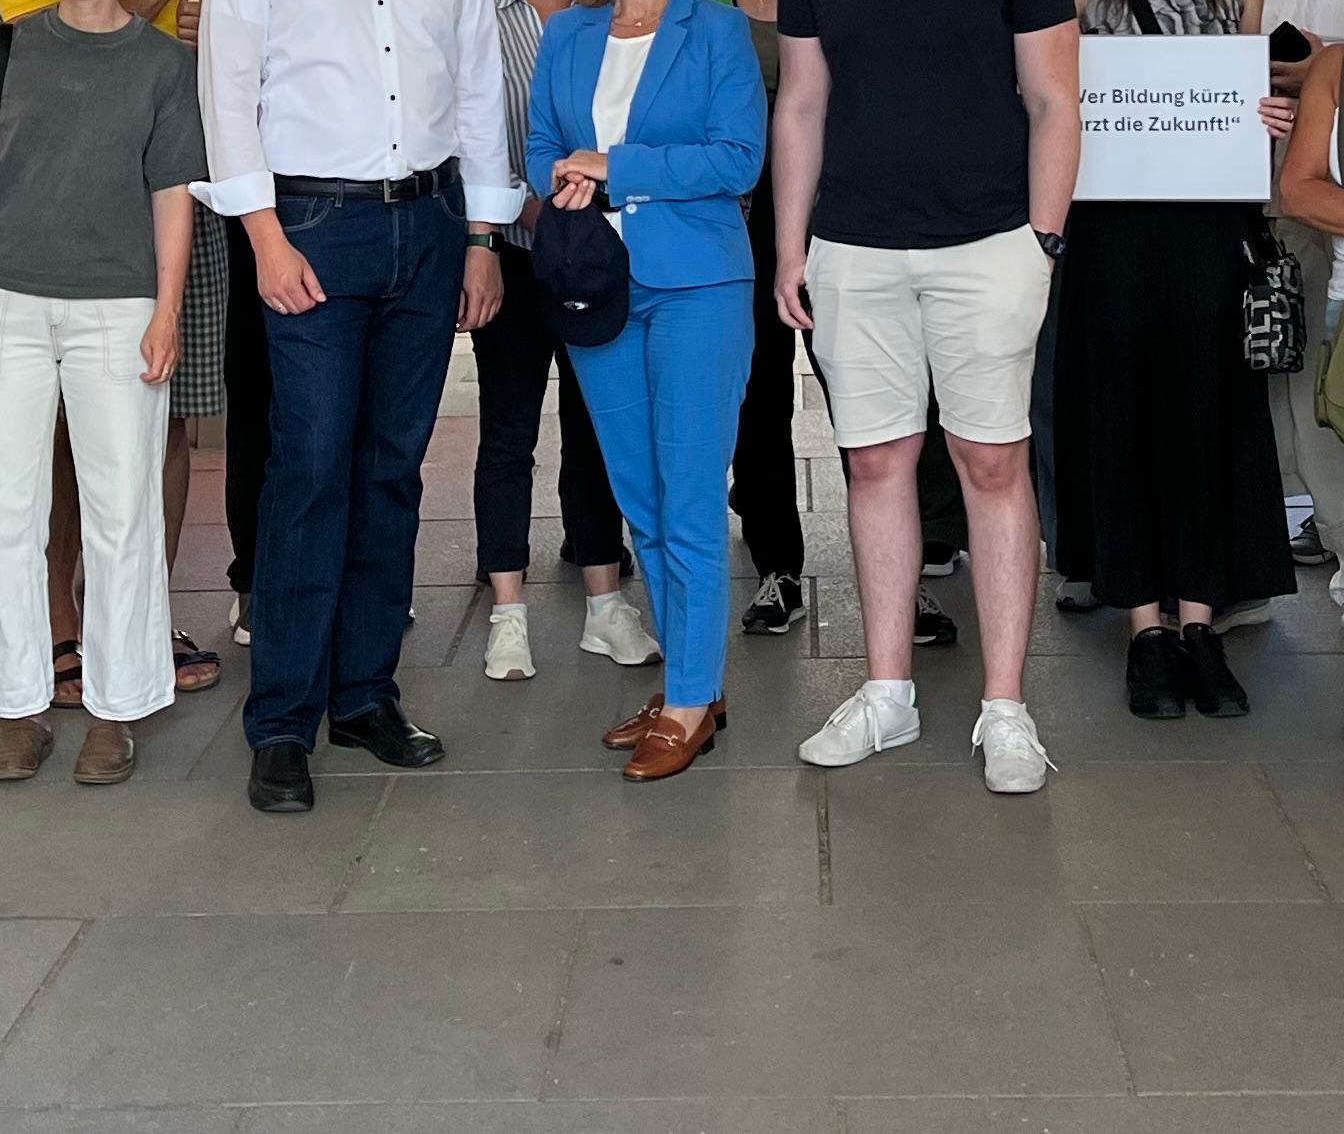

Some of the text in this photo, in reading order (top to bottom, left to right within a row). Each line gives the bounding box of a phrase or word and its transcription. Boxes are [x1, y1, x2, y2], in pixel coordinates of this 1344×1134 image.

[1111, 89, 1185, 107] Bildung
[1189, 88, 1245, 107] kürzt,
[1114, 116, 1144, 133] die
